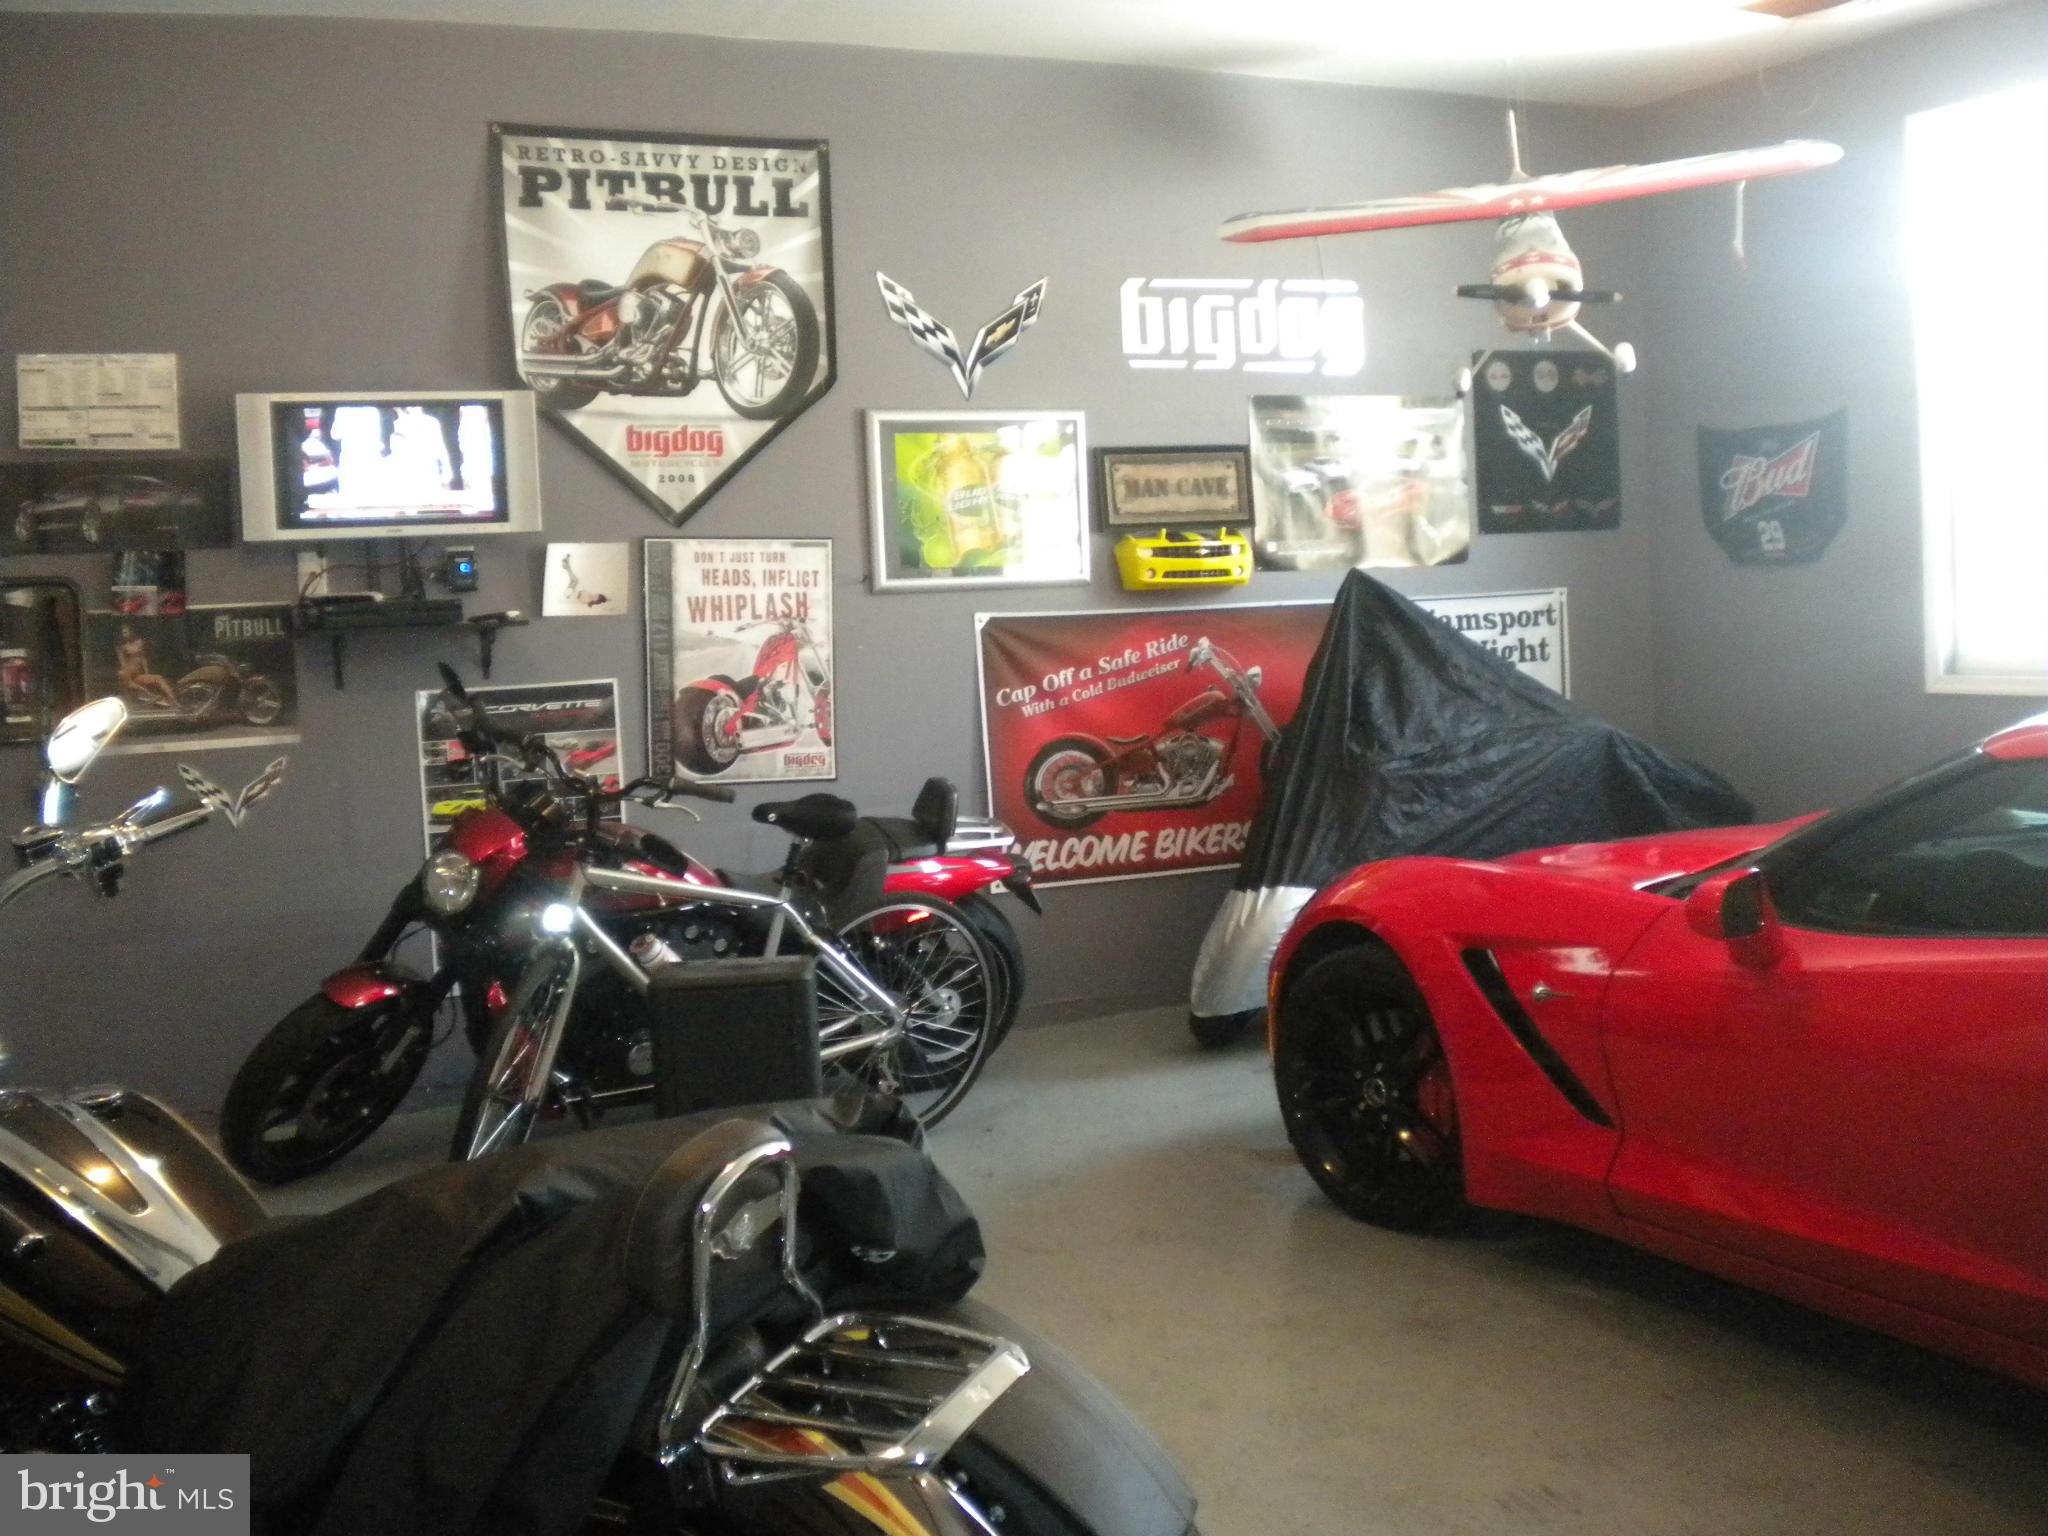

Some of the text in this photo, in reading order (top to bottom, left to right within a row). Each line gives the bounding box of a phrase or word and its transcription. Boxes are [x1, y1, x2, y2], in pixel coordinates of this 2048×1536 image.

[517, 145, 808, 174] RETRO-SAVVY DESIGN
[518, 165, 809, 217] PITBULL
[1120, 278, 1365, 376] bigdog
[626, 424, 724, 457] bigdog
[658, 474, 695, 483] 2008
[1176, 476, 1229, 497] CAVE
[1720, 438, 1814, 513] Bud
[730, 552, 754, 563] JUST
[760, 552, 786, 563] TURN
[702, 569, 819, 588] HEADS, INFLICT
[687, 592, 809, 622] WHIPLASH
[1430, 604, 1557, 635] amsport
[215, 617, 285, 638] PITBULL
[1481, 637, 1550, 666] ight
[996, 634, 1189, 707] Cap Off a Safe Ride
[1022, 659, 1181, 718] With a Cold Budweiser
[485, 700, 600, 714] CORVETTE
